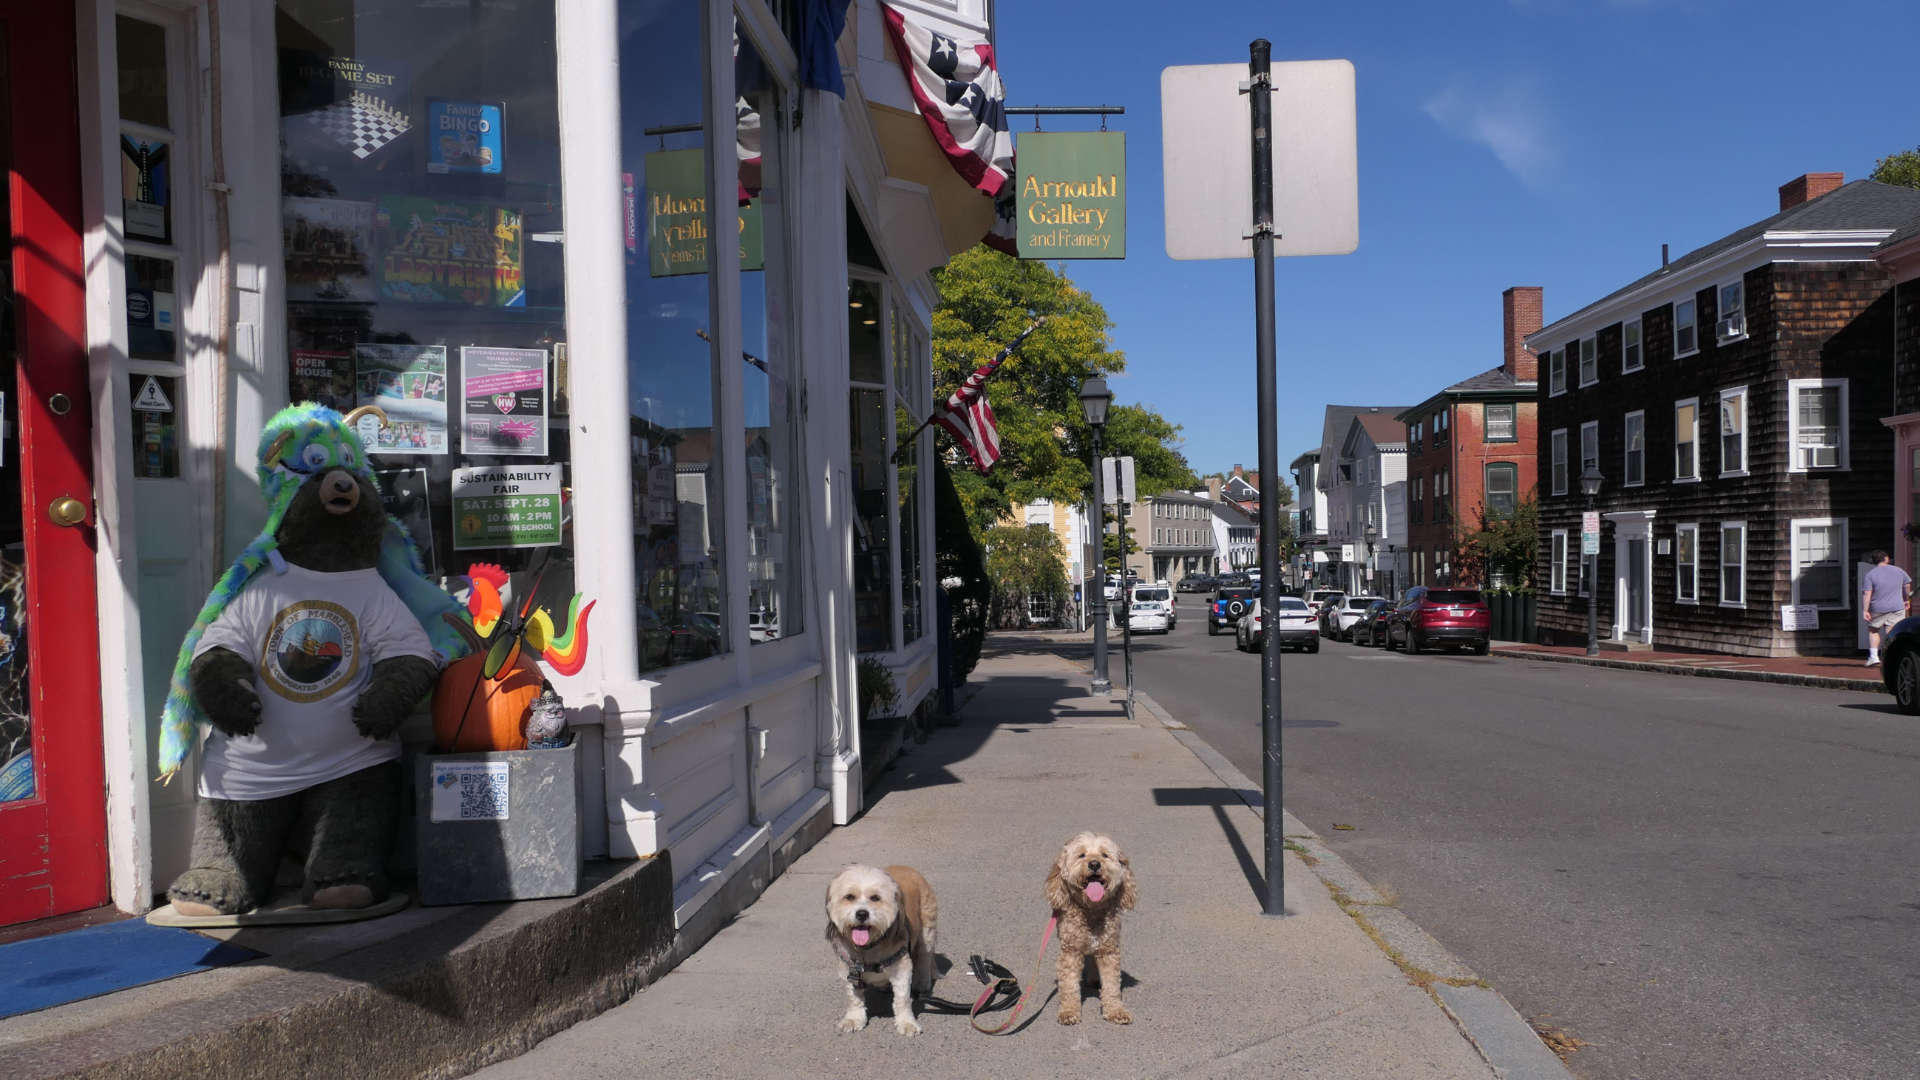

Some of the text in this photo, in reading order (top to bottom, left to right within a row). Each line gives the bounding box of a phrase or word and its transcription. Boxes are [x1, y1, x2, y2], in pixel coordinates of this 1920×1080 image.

[328, 61, 365, 71] FAMILY
[366, 72, 394, 85] SET
[447, 104, 483, 116] FAMILY
[440, 116, 490, 132] BINGO
[1023, 174, 1117, 198] Arnould
[1028, 200, 1110, 230] Gallery
[1029, 228, 1112, 251] and Framery
[384, 256, 520, 290] LABYRINTH
[295, 358, 326, 367] OPEN
[295, 367, 333, 377] HOUSE
[498, 398, 513, 407] HW
[460, 472, 552, 484] SUSTAINABILITY
[493, 485, 520, 494] FAIR
[463, 498, 550, 510] SAT. SEPT. 28
[487, 513, 500, 522] 10
[502, 513, 520, 522] AM
[527, 512, 535, 520] 2
[535, 512, 552, 520] PM
[521, 523, 554, 531] SCHOOL
[268, 610, 353, 658] TOWN OF MARBLEHEAD
